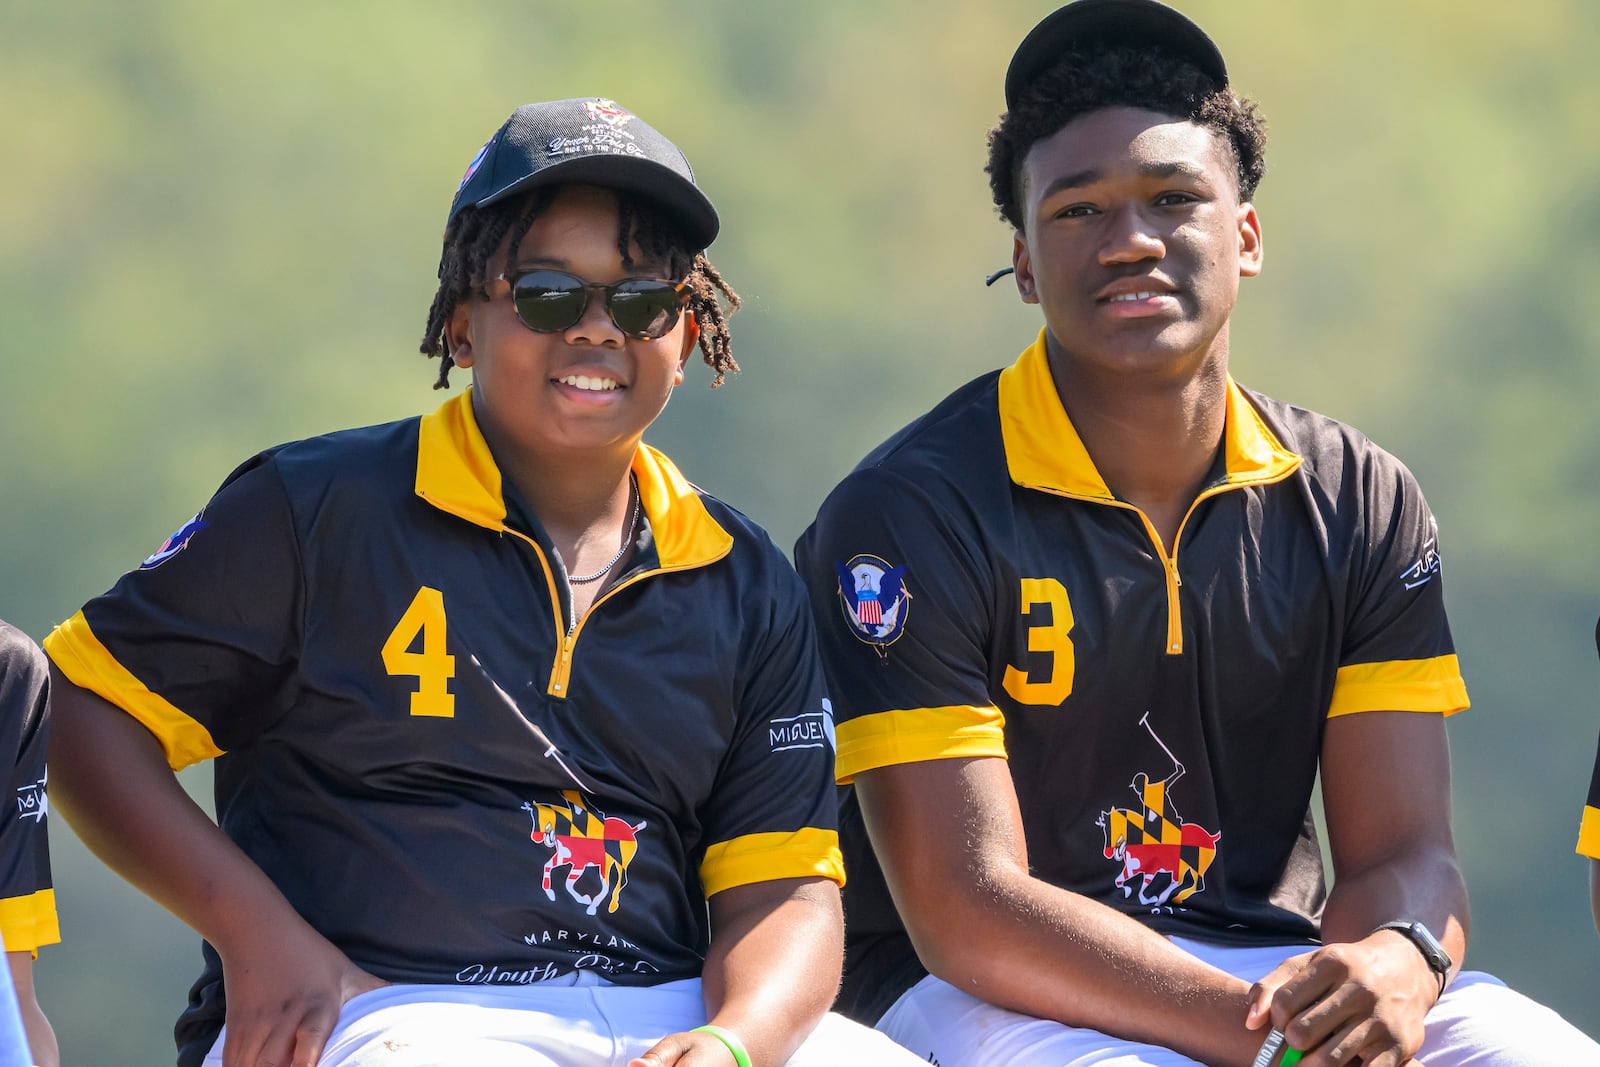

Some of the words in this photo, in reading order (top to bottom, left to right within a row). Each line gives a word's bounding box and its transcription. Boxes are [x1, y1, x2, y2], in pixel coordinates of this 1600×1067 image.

[381, 585, 455, 718] 4
[1002, 577, 1075, 706] 3
[524, 930, 640, 950] MARYLAN
[1269, 1030, 1285, 1044] IN
